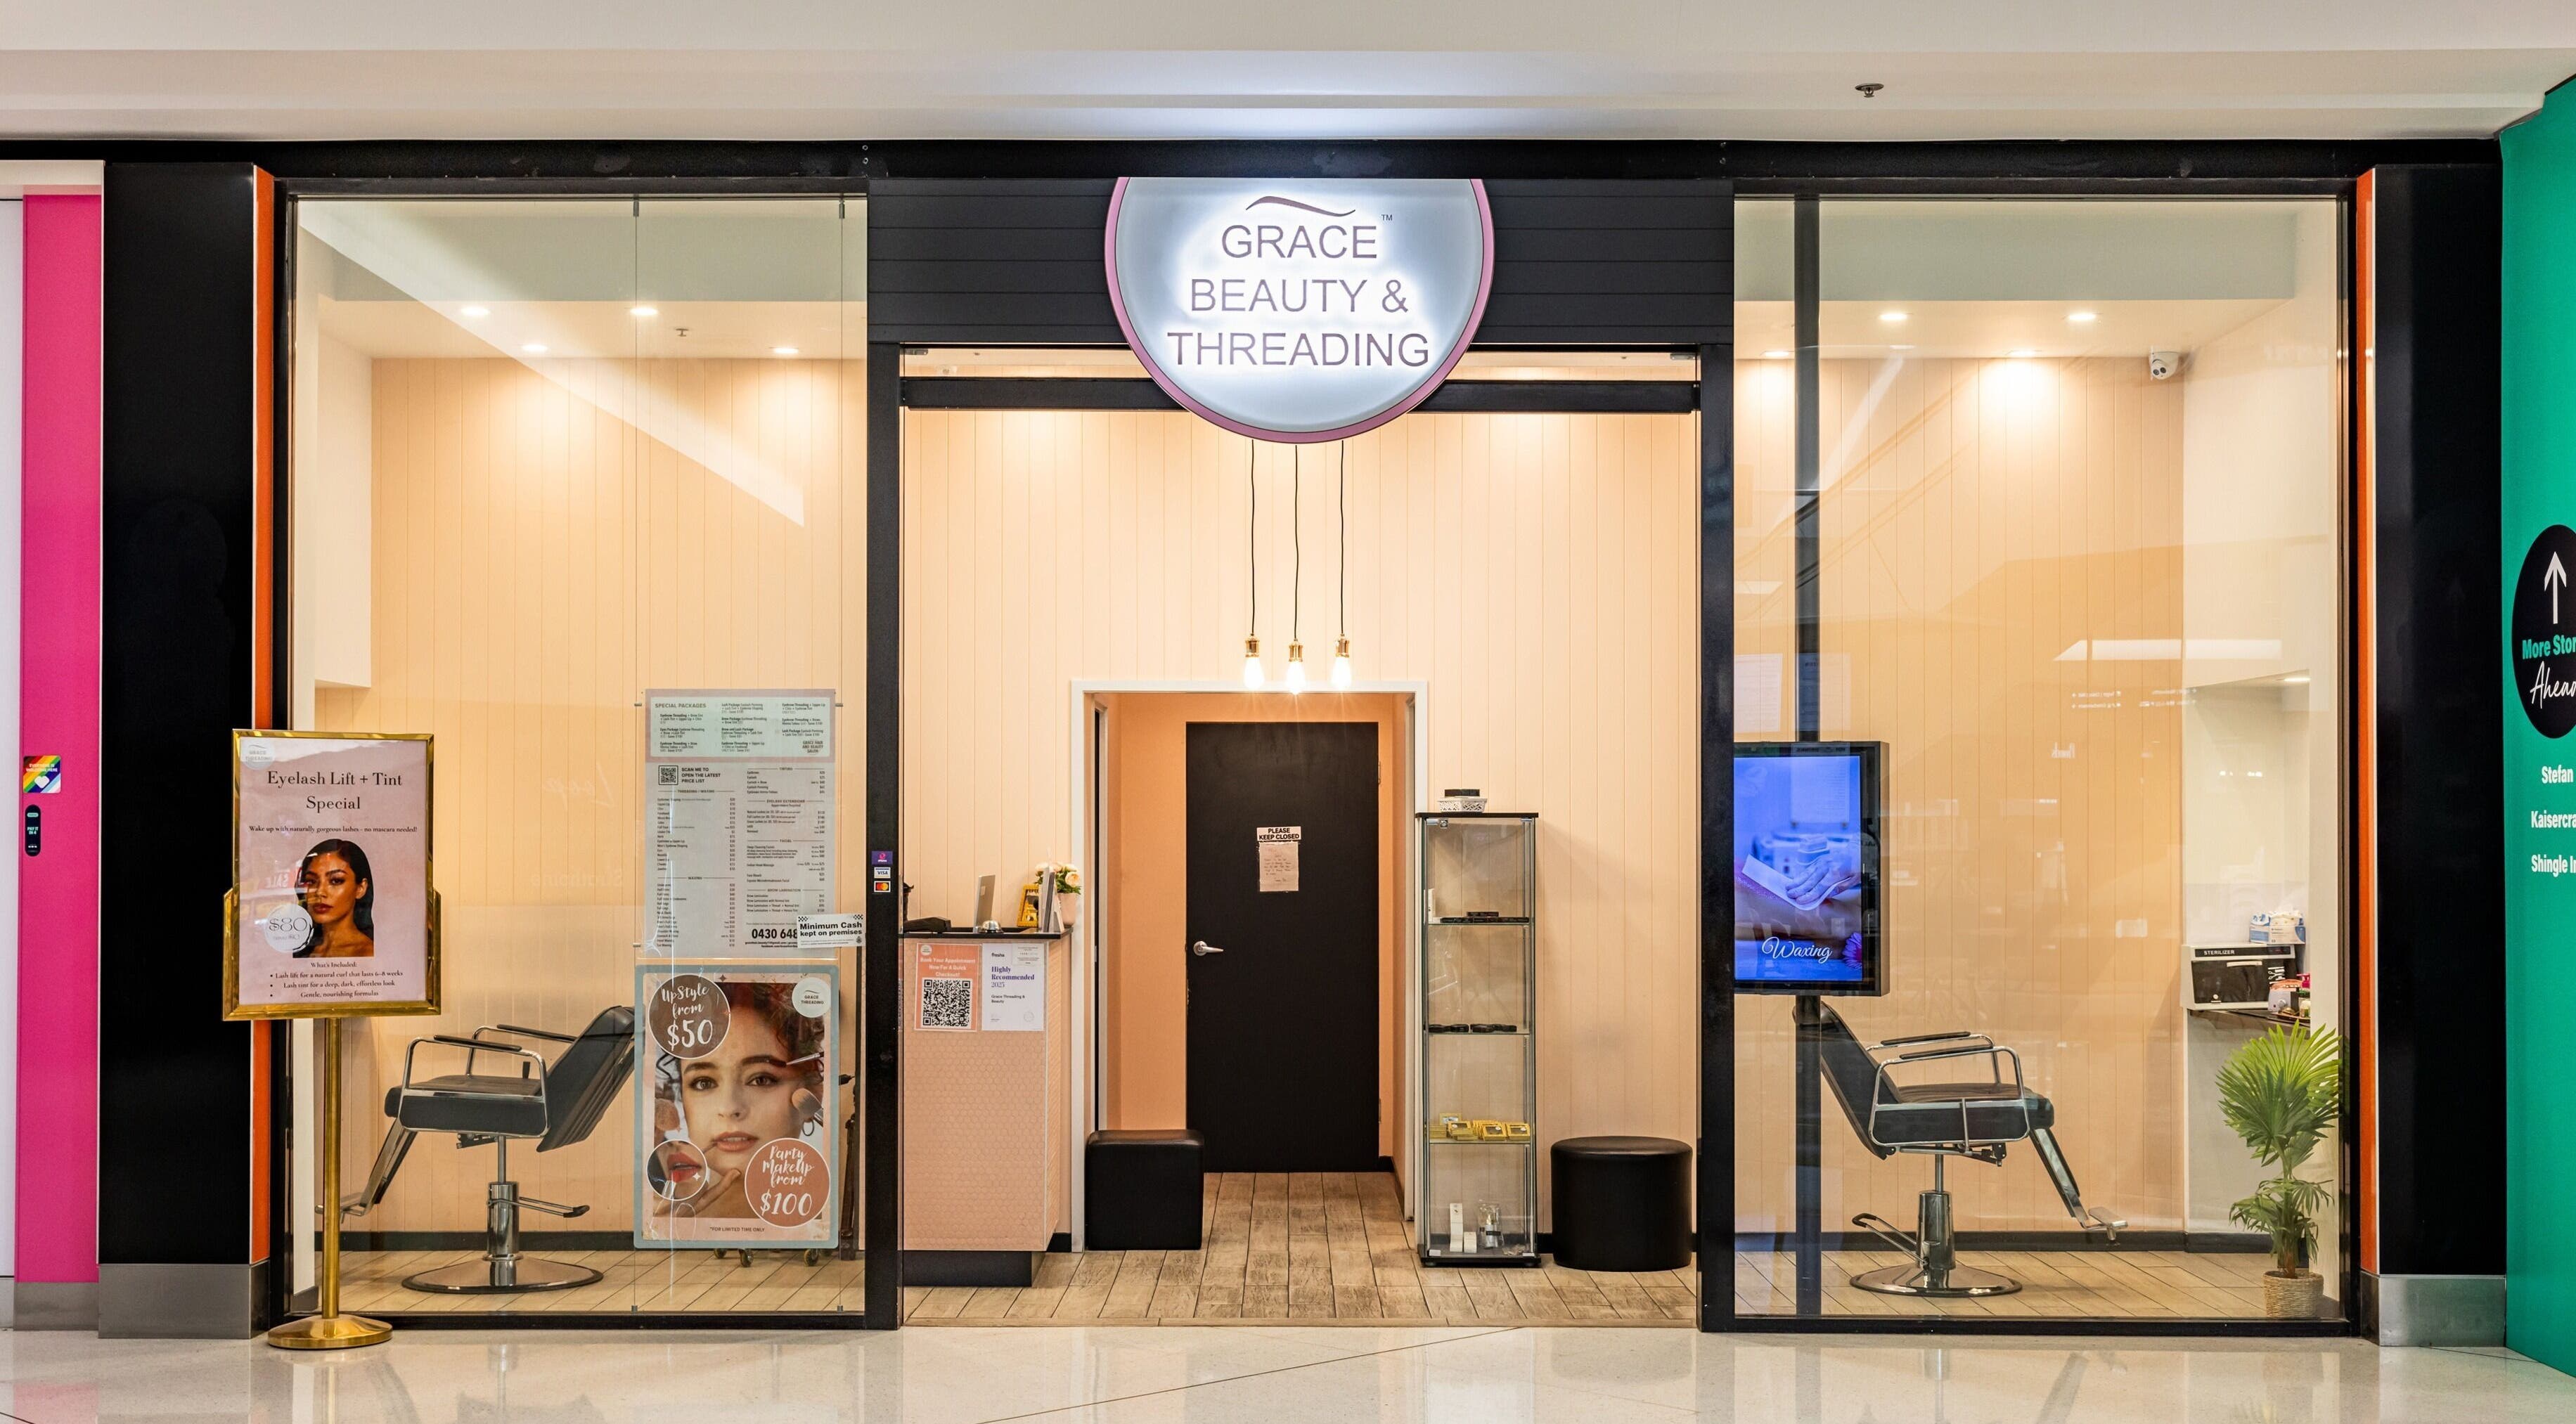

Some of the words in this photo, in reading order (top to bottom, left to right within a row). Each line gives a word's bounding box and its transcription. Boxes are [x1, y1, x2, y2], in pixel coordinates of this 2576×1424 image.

[1223, 225, 1377, 258] GRACE
[1192, 279, 1367, 311] BEAUTY
[1382, 279, 1408, 312] &
[1168, 332, 1429, 366] THREADING
[2523, 639, 2551, 659] More
[268, 771, 325, 788] Eyelash
[330, 772, 356, 785] Lift
[373, 772, 402, 786] Tint
[2542, 765, 2573, 784] Stefan
[307, 796, 360, 813] Special
[2531, 854, 2568, 877] Shingle
[269, 917, 307, 932] $80
[752, 928, 777, 939] 0430
[780, 928, 797, 939] 648
[1762, 936, 1832, 964] Waxing
[662, 983, 709, 1004] UpStyle
[673, 1003, 704, 1019] from
[667, 1019, 712, 1051] $50
[770, 1146, 808, 1160] Party
[763, 1158, 814, 1177] MakeUp
[771, 1174, 806, 1188] from
[760, 1189, 812, 1216] $100
